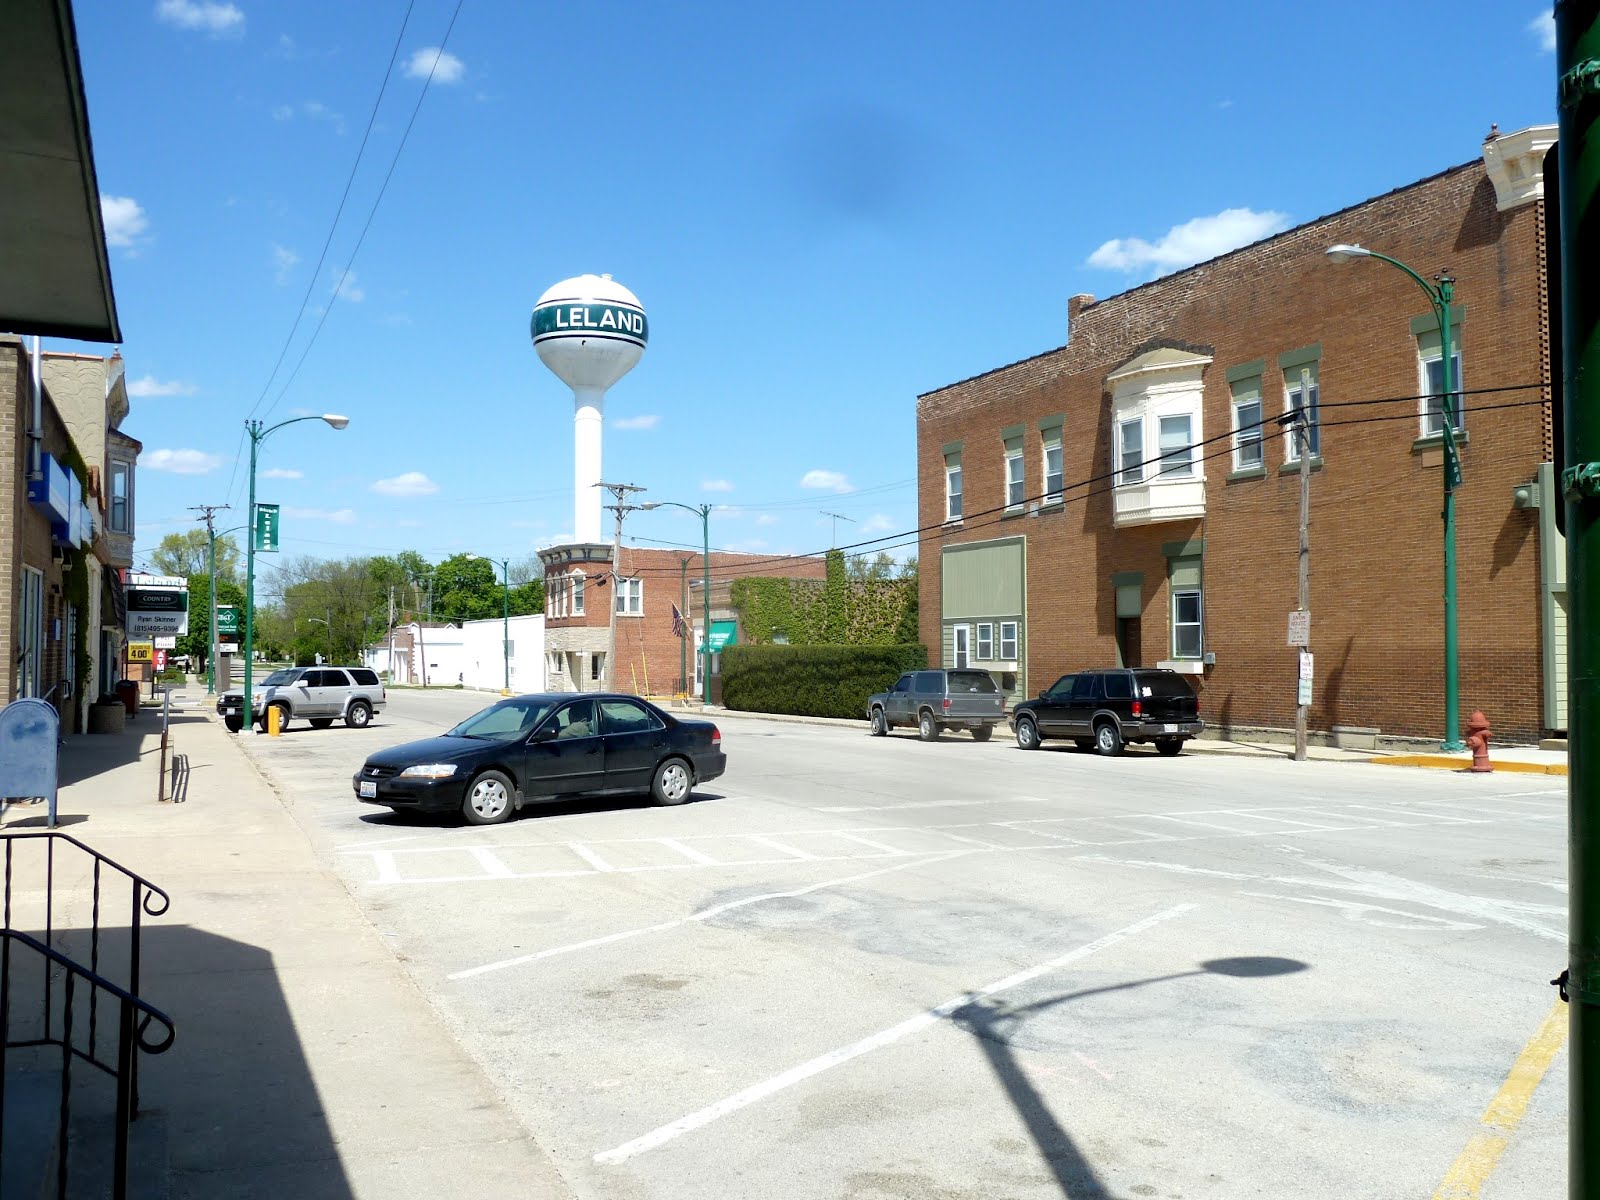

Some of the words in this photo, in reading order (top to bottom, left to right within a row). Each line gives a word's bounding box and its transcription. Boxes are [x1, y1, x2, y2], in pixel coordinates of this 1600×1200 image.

[556, 307, 643, 334] LELAND
[137, 615, 152, 623] Ryan
[156, 651, 165, 670] ATM
